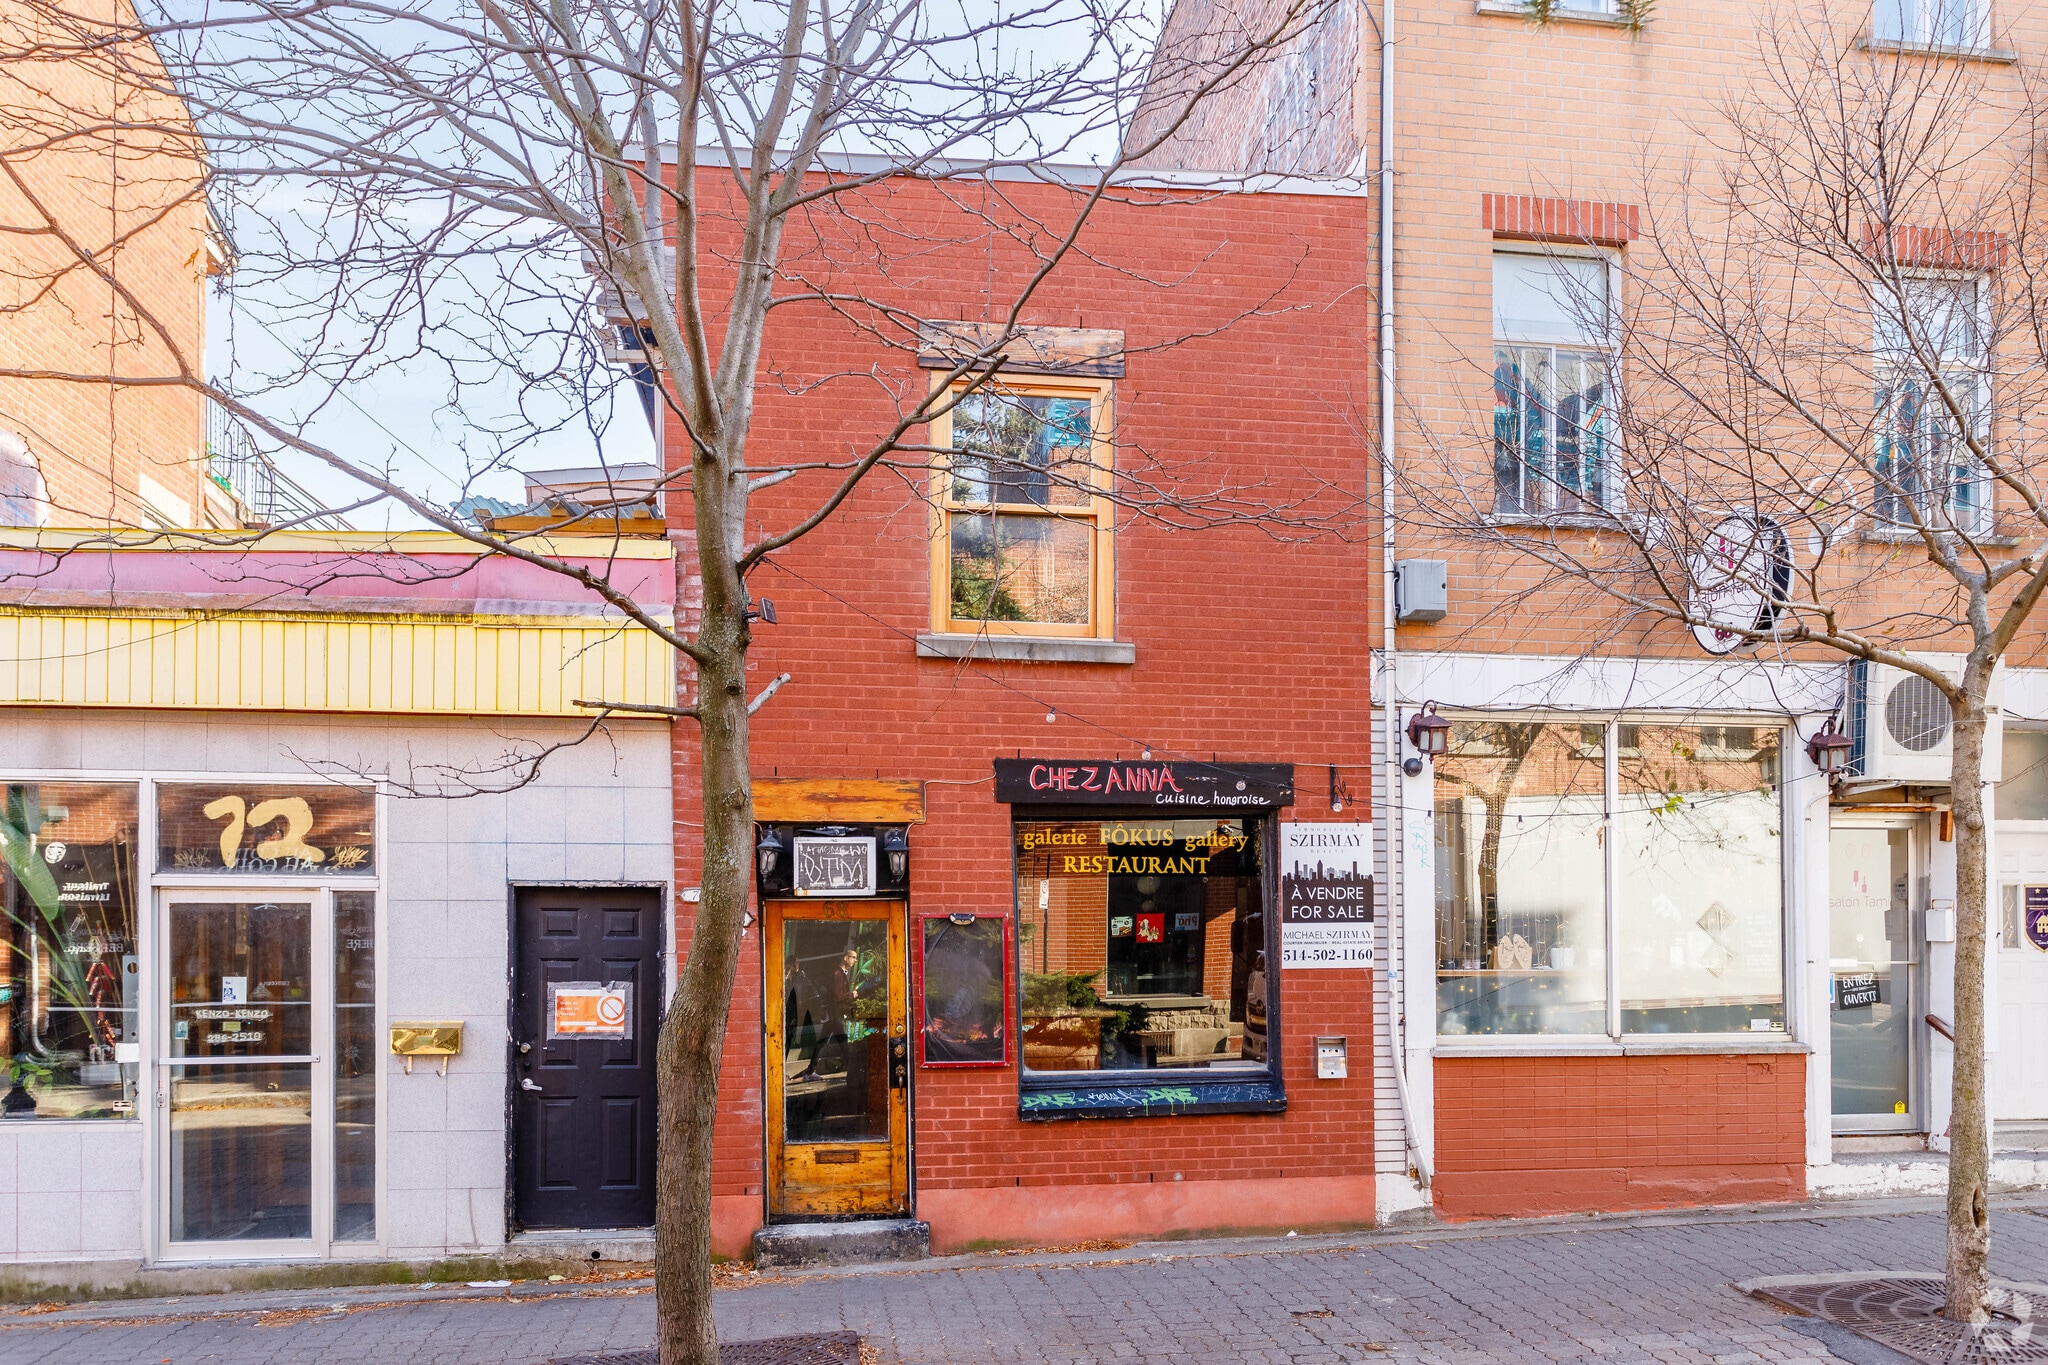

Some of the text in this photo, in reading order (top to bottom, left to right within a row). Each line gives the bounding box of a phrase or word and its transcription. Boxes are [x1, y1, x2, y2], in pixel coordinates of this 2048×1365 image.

[1030, 764, 1184, 794] CHEZ ANNA
[1213, 791, 1271, 806] hongroise
[1023, 823, 1249, 852] galerie FÔKUS gallery
[1290, 833, 1364, 847] SZIRMAY
[1062, 855, 1211, 874] RESTAURANT
[1291, 884, 1364, 900] À VENDRE
[823, 901, 848, 919] 68
[1291, 905, 1364, 919] FOR SALE
[1283, 930, 1372, 940] MICHAEL SZIRMAY
[1283, 948, 1373, 961] 514-502-1160
[1842, 973, 1874, 988] ENTREZ
[1844, 990, 1877, 1006] OUVERTS
[195, 1009, 270, 1020] KENZO-KENZO
